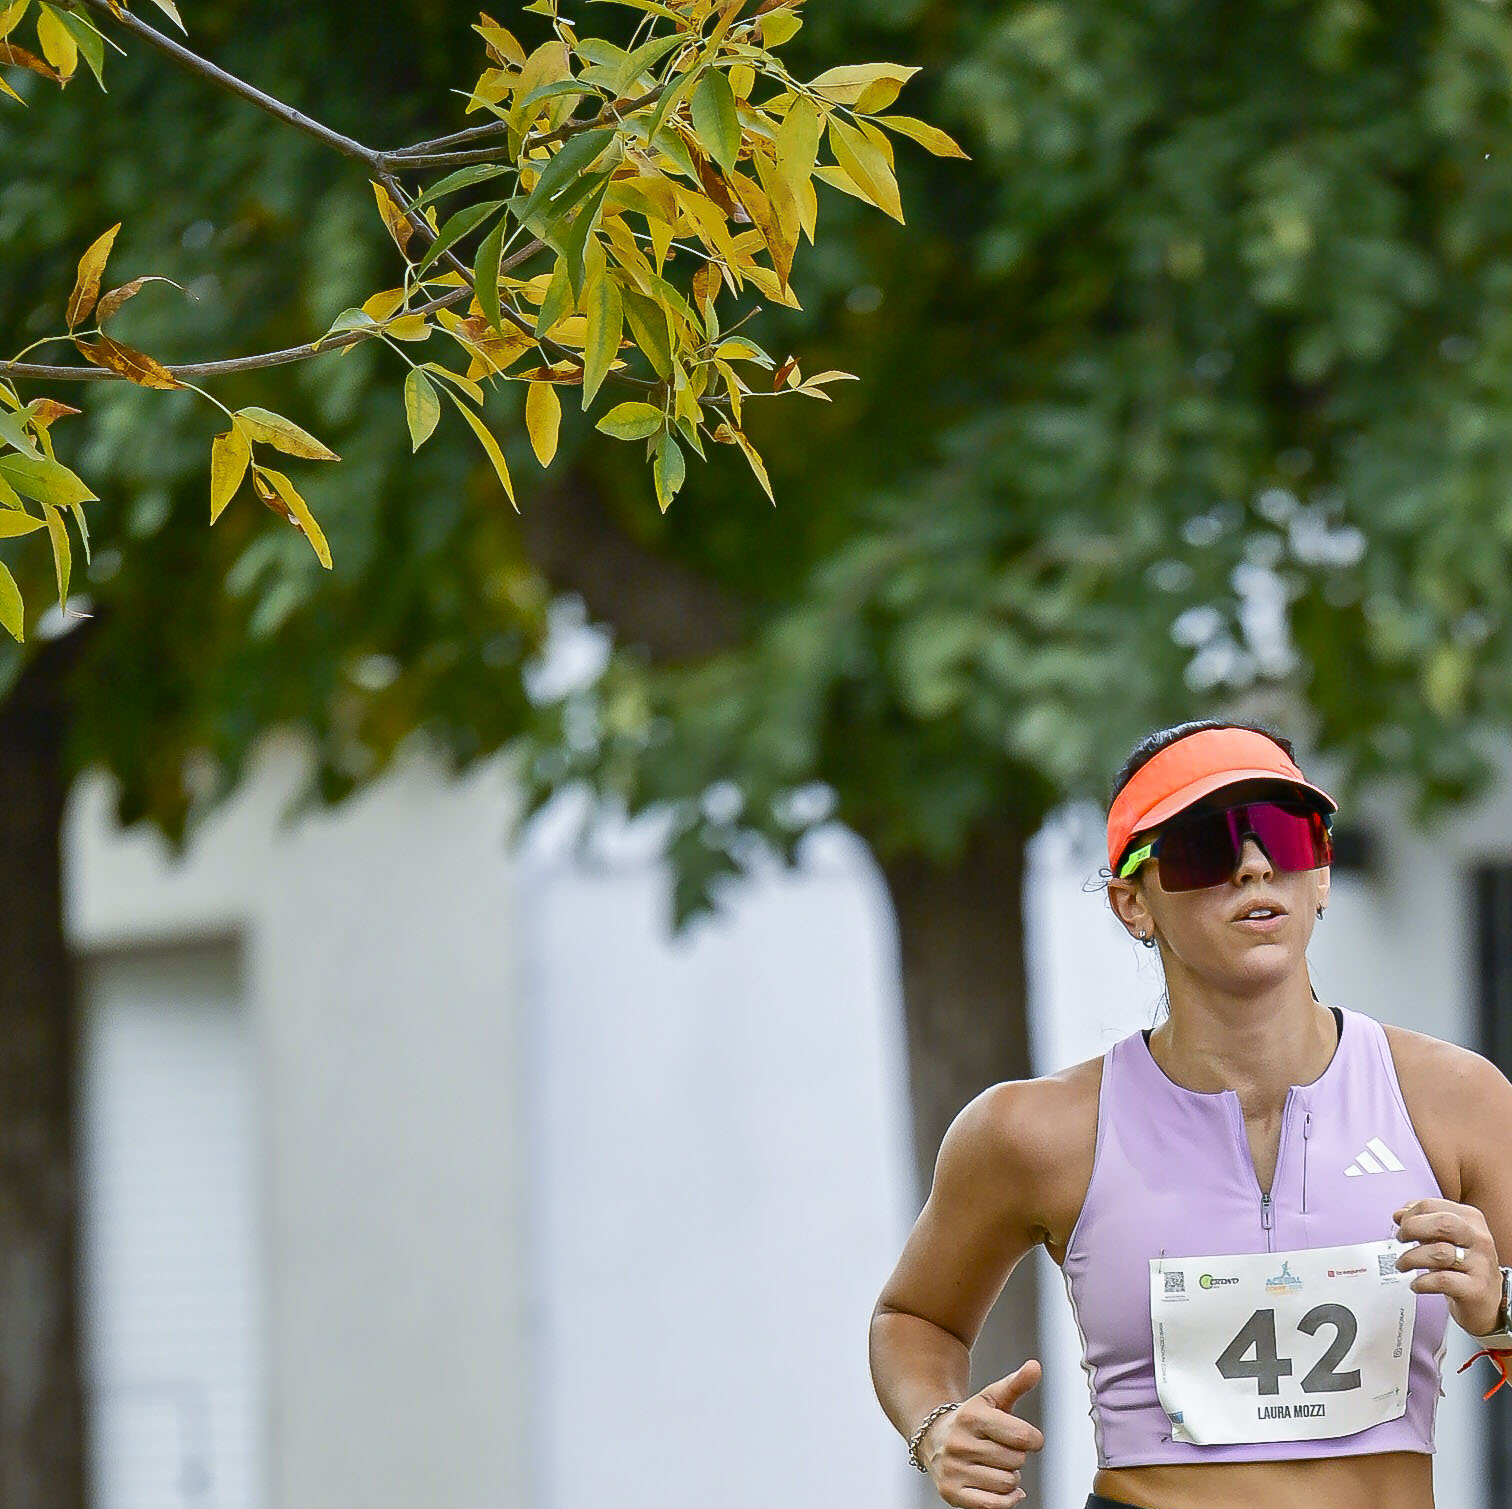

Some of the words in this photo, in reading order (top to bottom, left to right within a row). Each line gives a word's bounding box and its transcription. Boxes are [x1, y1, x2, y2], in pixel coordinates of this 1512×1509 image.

[1215, 1303, 1361, 1395] 42
[1258, 1405, 1291, 1419] LAURA
[1294, 1404, 1325, 1418] MOZZI
